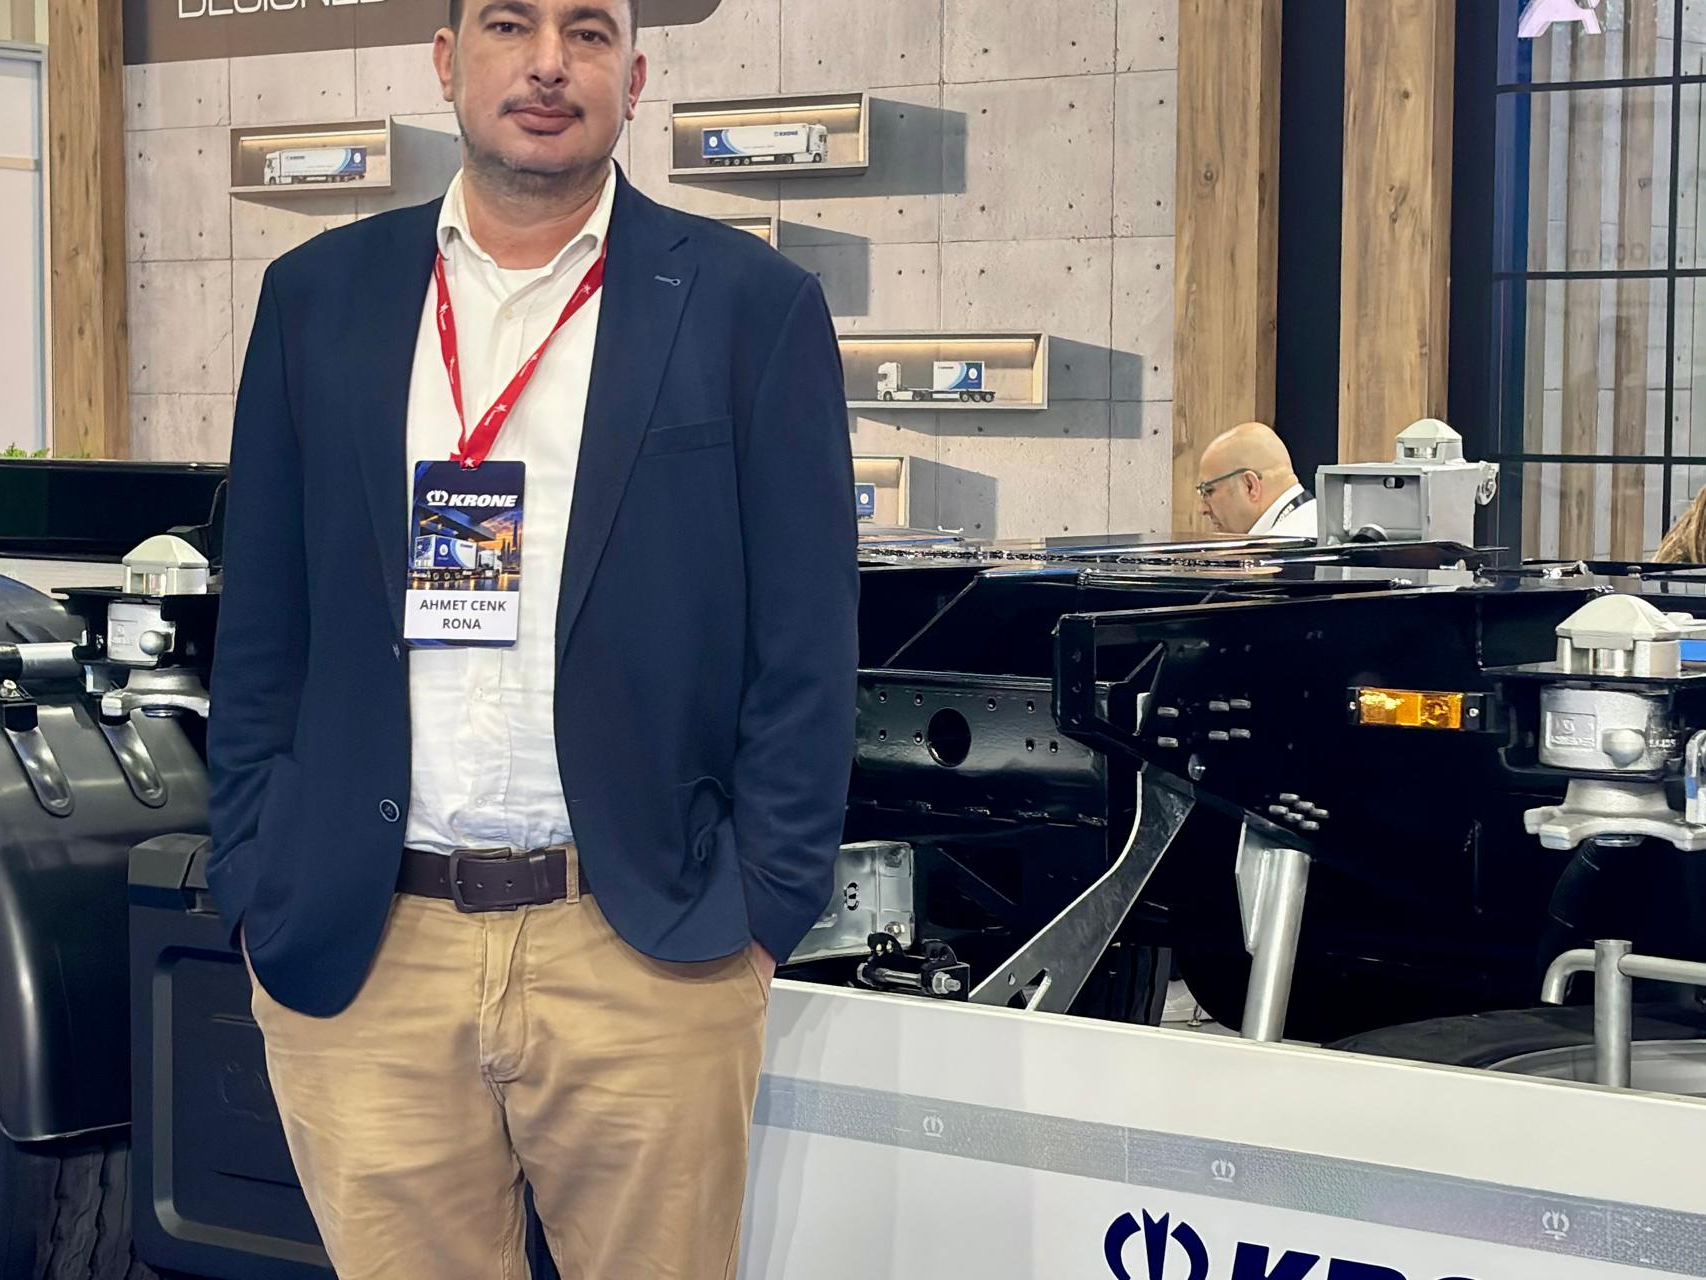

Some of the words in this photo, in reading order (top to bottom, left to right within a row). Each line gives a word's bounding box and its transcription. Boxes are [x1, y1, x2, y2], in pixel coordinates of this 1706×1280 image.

[448, 494, 518, 508] KRONE
[419, 599, 468, 612] AHMET
[470, 599, 508, 612] CENK
[442, 617, 482, 630] RONA
